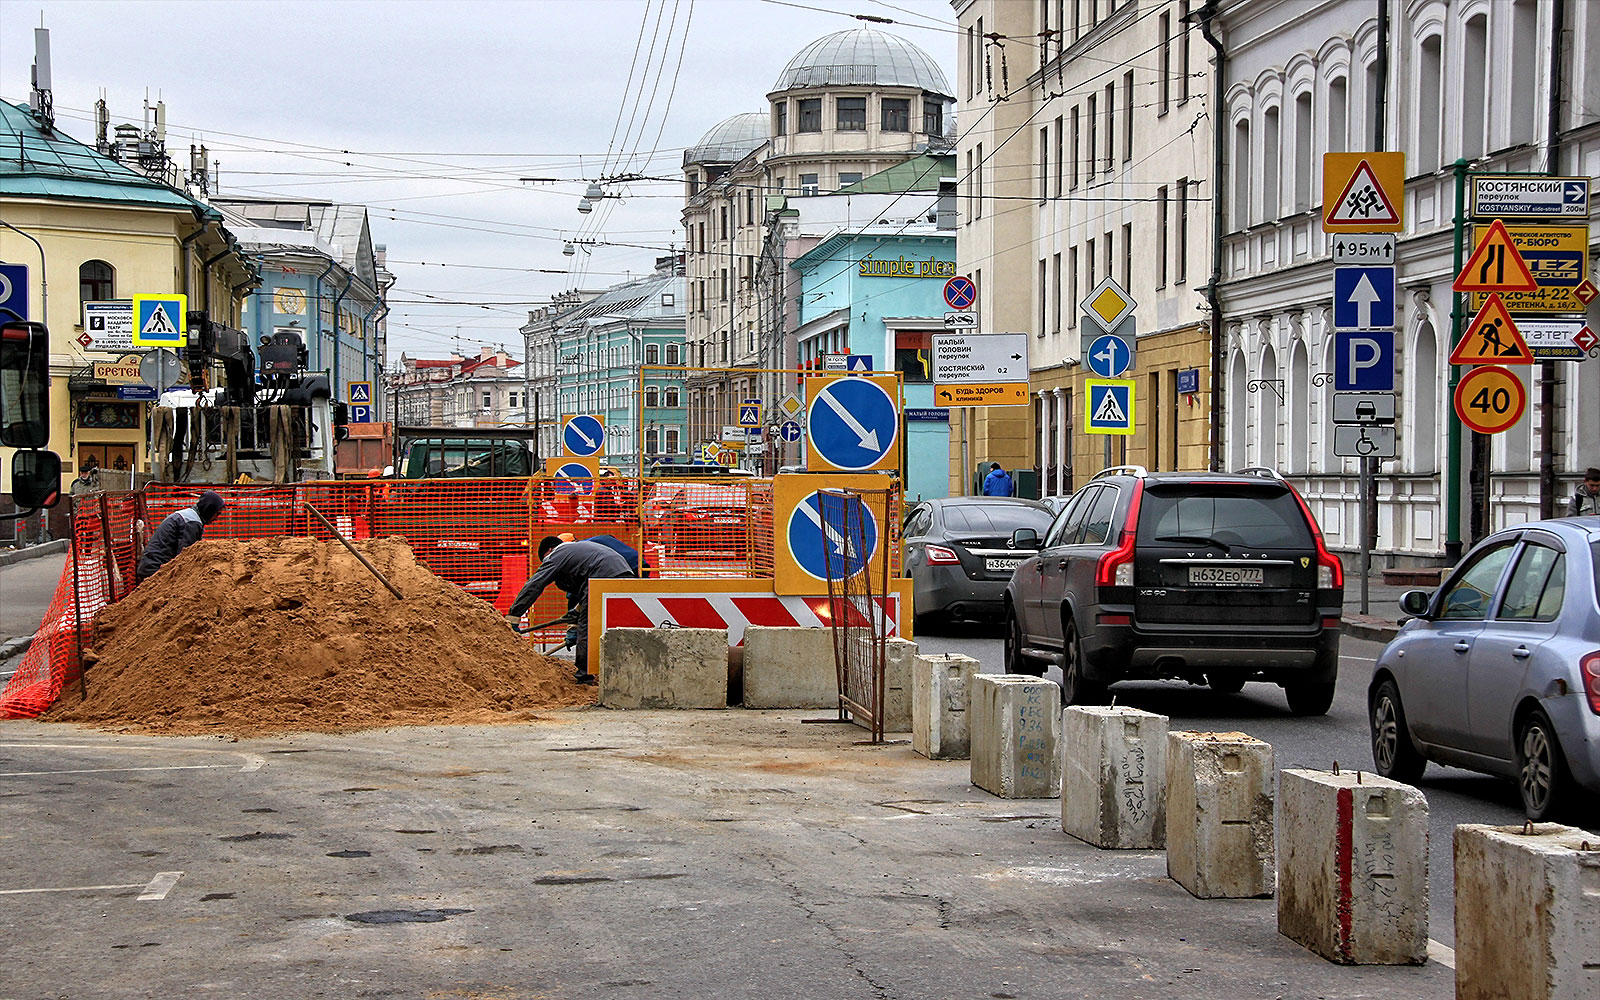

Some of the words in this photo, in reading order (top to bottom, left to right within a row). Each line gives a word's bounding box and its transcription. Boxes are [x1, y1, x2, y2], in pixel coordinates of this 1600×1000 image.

[1478, 181, 1562, 193] КОСТЯНСКИЙ
[1478, 194, 1520, 202] переулок
[1479, 204, 1532, 212] KOSTYANSKIY
[1565, 205, 1585, 213] 200м
[859, 253, 915, 277] simple
[1506, 301, 1547, 309] СРЕТЕНКА,
[1557, 301, 1577, 309] 16/2
[975, 387, 1004, 395] ЗДОРОВ
[1470, 387, 1510, 414] 40
[1242, 569, 1261, 579] 777
